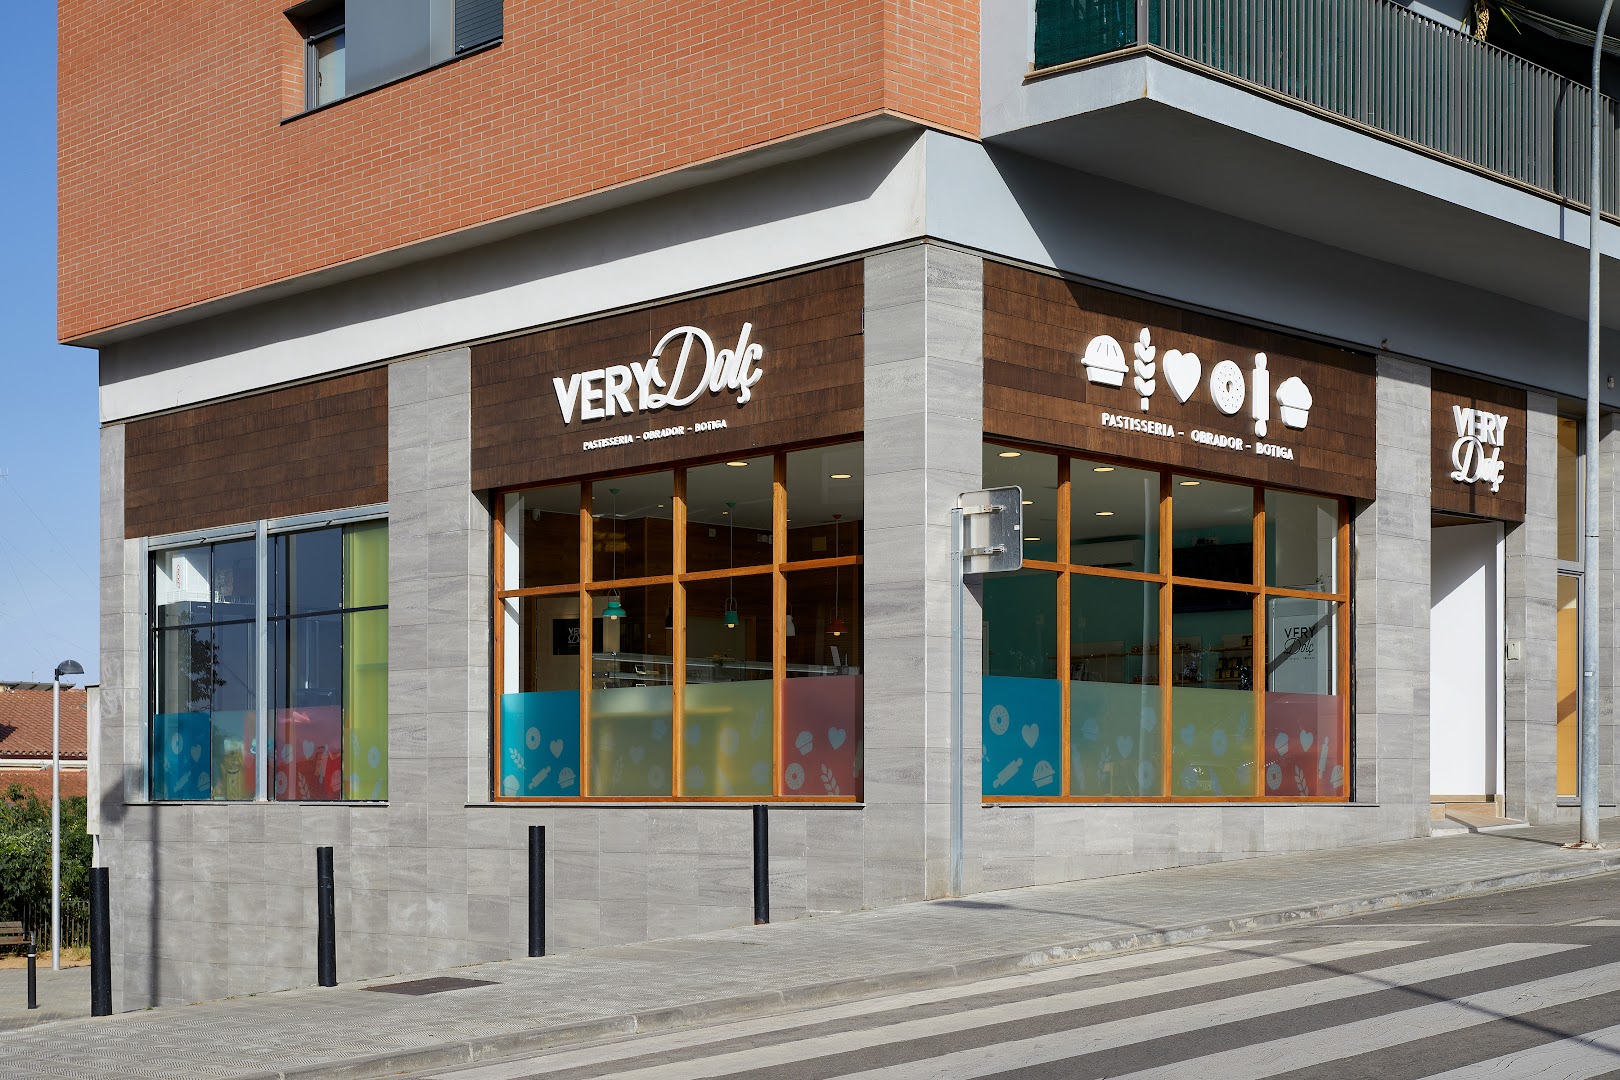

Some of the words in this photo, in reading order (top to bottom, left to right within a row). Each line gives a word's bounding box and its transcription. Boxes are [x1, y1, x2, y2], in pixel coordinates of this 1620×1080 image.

[552, 358, 658, 424] VERY
[647, 322, 763, 409] Dolç
[583, 434, 634, 451] PASTISSERIA
[643, 425, 685, 441] OBRADOR
[695, 419, 727, 433] BOTIGA
[1101, 412, 1175, 438] PASTISSERIA
[1191, 430, 1244, 451] OBRADOR
[1256, 442, 1294, 461] BOTIGA
[1452, 405, 1508, 447] VERY
[1284, 626, 1316, 638] VERY
